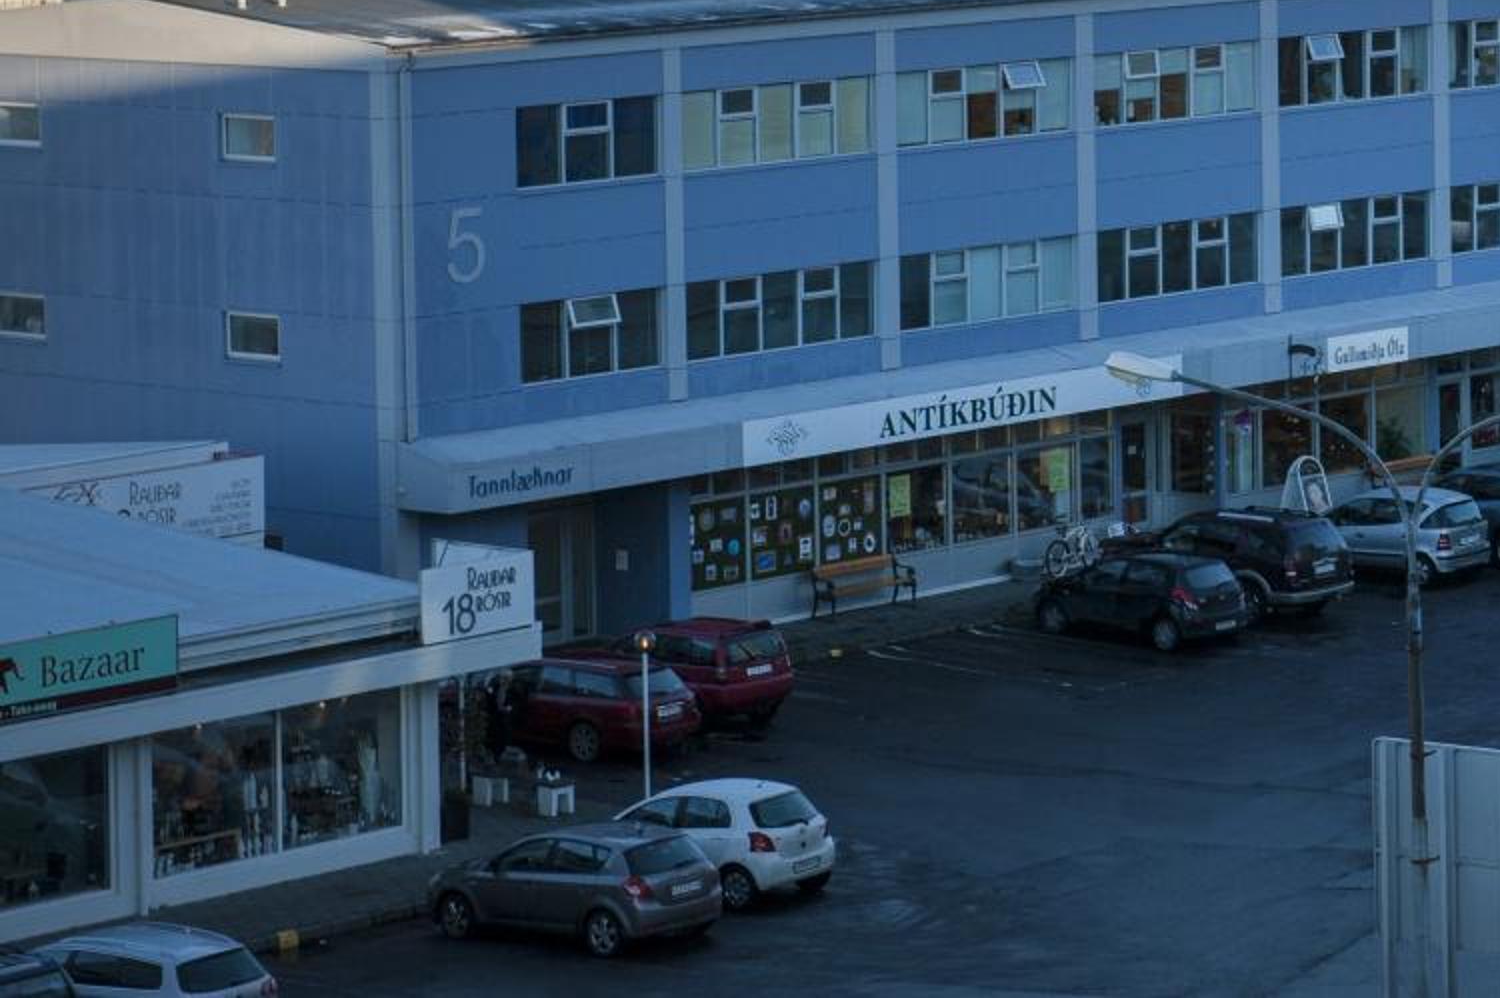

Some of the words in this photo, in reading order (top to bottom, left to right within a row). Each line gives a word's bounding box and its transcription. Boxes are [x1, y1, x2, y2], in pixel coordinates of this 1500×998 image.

[447, 207, 485, 282] 5
[880, 385, 1057, 439] ANTÍKBÚÐIN
[467, 465, 575, 499] Tannlæknar
[442, 593, 476, 635] 18
[40, 647, 145, 689] Bazaar
